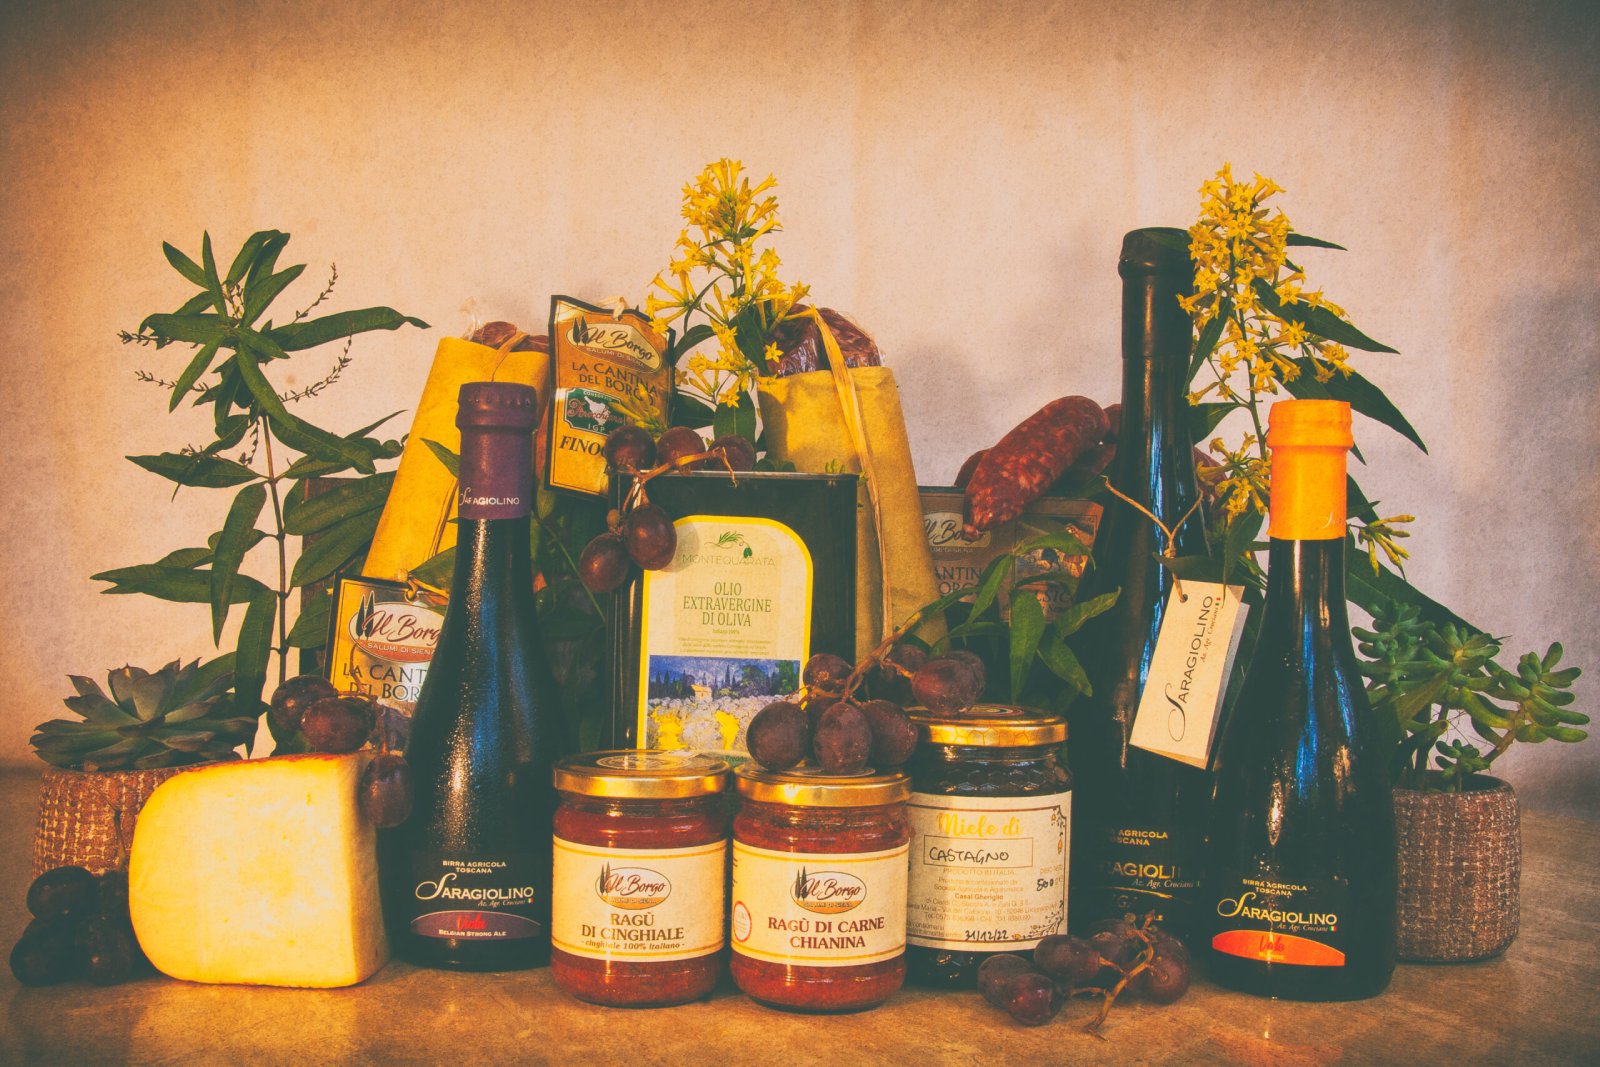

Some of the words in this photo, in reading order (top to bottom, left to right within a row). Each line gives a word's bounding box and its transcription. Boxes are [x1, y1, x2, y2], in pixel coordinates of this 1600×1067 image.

[603, 331, 654, 361] Borgo
[572, 362, 588, 372] LA
[579, 374, 600, 386] DEL
[713, 582, 742, 596] OLIO
[682, 595, 772, 613] EXTRAVERGINE
[362, 610, 395, 638] Il
[701, 611, 715, 625] DI
[717, 612, 751, 627] OLIVA
[367, 642, 399, 653] SALUMI
[343, 663, 363, 678] LA
[1164, 596, 1214, 743] SARAGIOLINO
[936, 812, 996, 838] Miele
[1002, 816, 1021, 837] di
[1118, 829, 1169, 840] AGRICOLA
[928, 846, 1010, 865] CASTAGNO
[415, 873, 534, 900] SARAGIOLINO
[604, 873, 624, 894] Il
[619, 874, 667, 898] Borgo
[800, 878, 820, 897] Il
[815, 877, 863, 901] Borgo
[1242, 878, 1265, 888] BIRRA
[1265, 880, 1308, 892] AGRICOLA
[1255, 886, 1293, 897] TOSCANA
[1217, 891, 1338, 926] SARAGIOLINO
[610, 911, 654, 927] RAGÙ
[768, 917, 810, 933] RAGÙ
[815, 921, 833, 933] DI
[837, 916, 885, 934] CARNE
[581, 924, 596, 938] DI
[600, 927, 685, 941] CINGHIALE
[964, 929, 1009, 942] 31/12/22
[623, 942, 647, 950] 100%
[789, 936, 867, 949] CHIANINA
